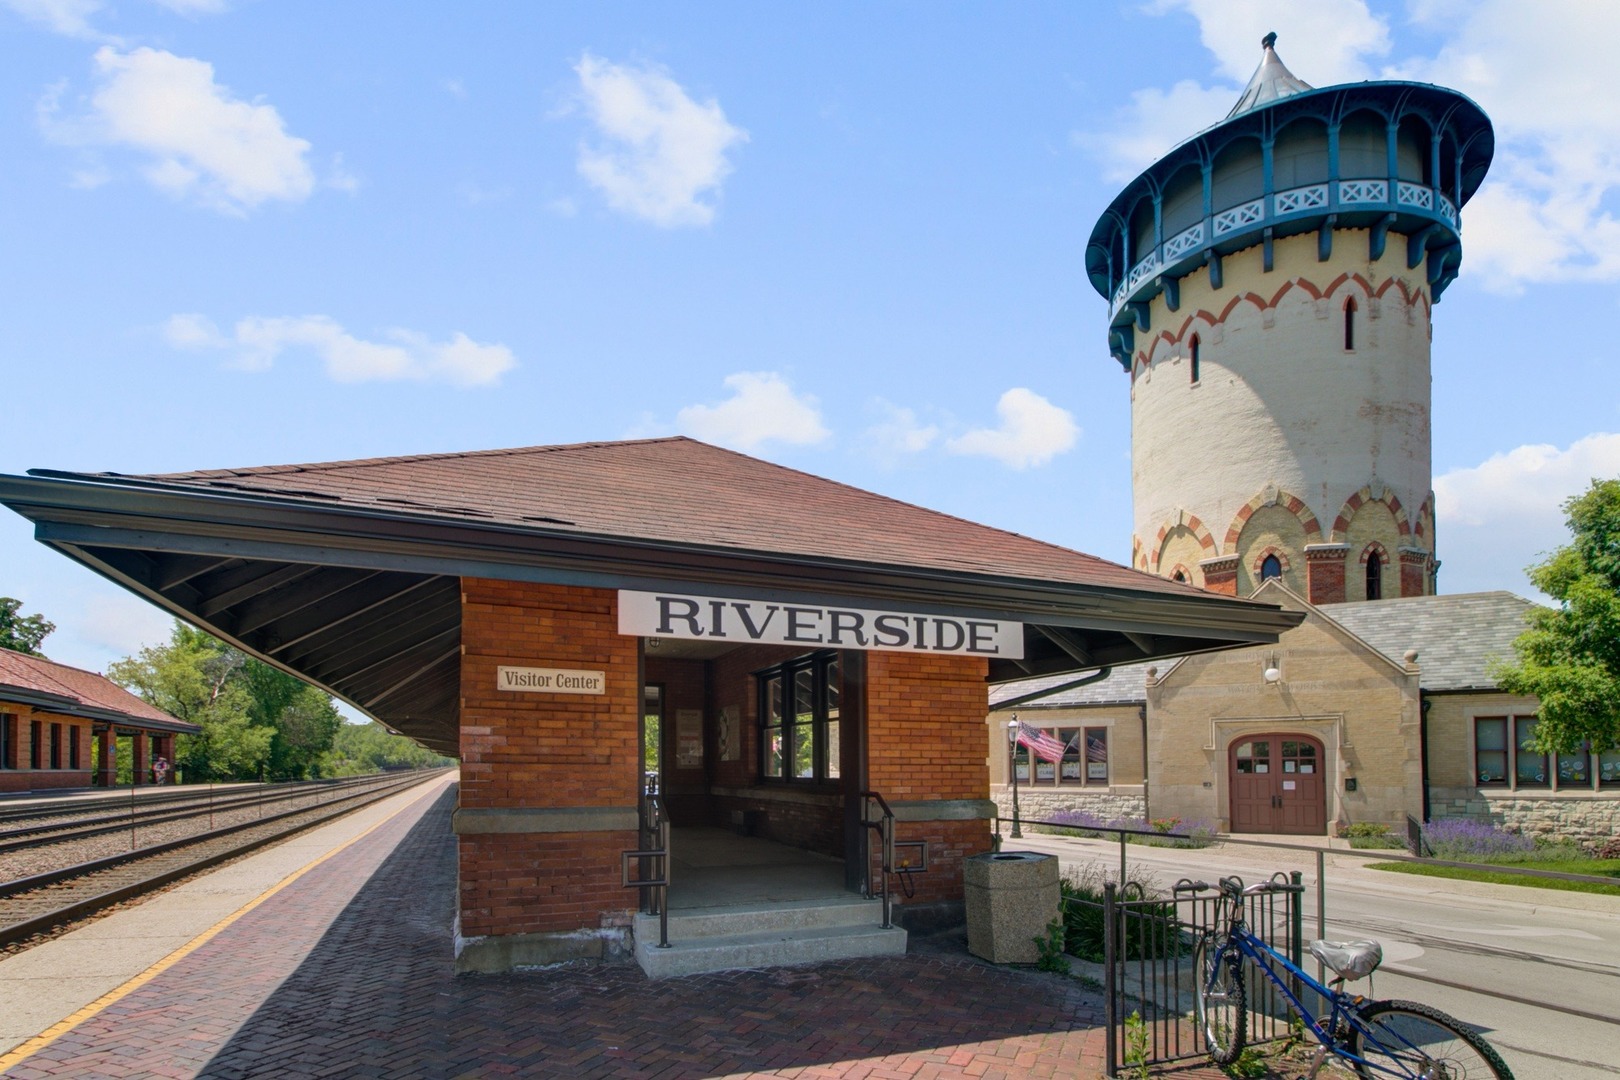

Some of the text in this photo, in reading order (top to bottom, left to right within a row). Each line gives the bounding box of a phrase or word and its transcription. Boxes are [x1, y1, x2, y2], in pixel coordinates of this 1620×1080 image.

[655, 596, 999, 654] RIVERSIDE
[505, 671, 599, 689] Visitor Center
